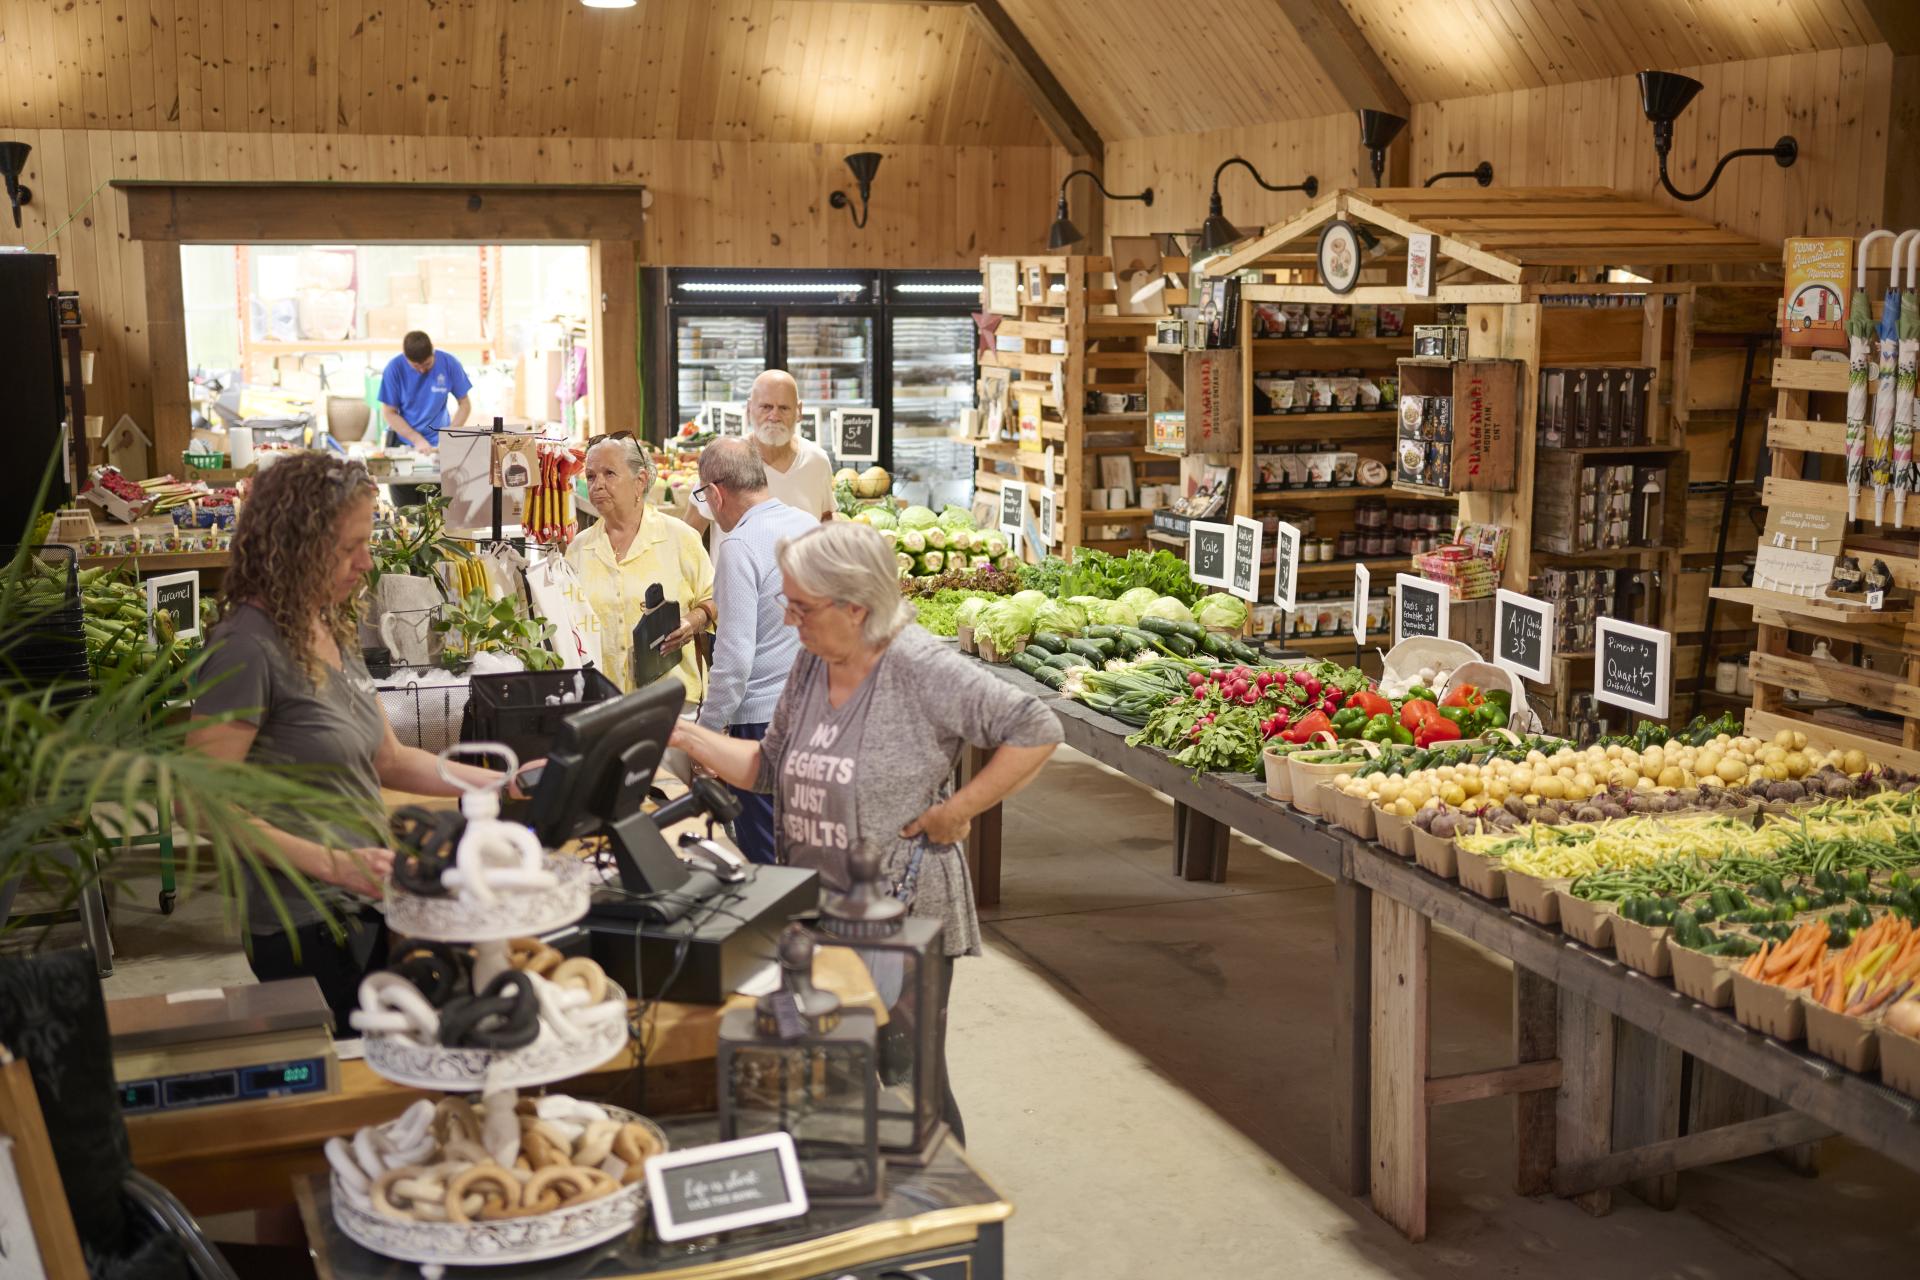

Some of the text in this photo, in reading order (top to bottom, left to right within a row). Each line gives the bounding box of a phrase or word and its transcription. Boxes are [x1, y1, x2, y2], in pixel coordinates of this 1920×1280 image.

[1483, 407, 1491, 453] MOUNTAIN
[1201, 537, 1219, 553] Kale
[157, 584, 190, 603] Caramel
[1512, 637, 1527, 659] 3$
[1608, 636, 1635, 653] Piment
[1608, 657, 1638, 684] Quart
[810, 722, 839, 749] NO
[784, 750, 855, 785] EGRETS
[790, 783, 827, 814] JUST
[784, 814, 849, 850] ESULTS
